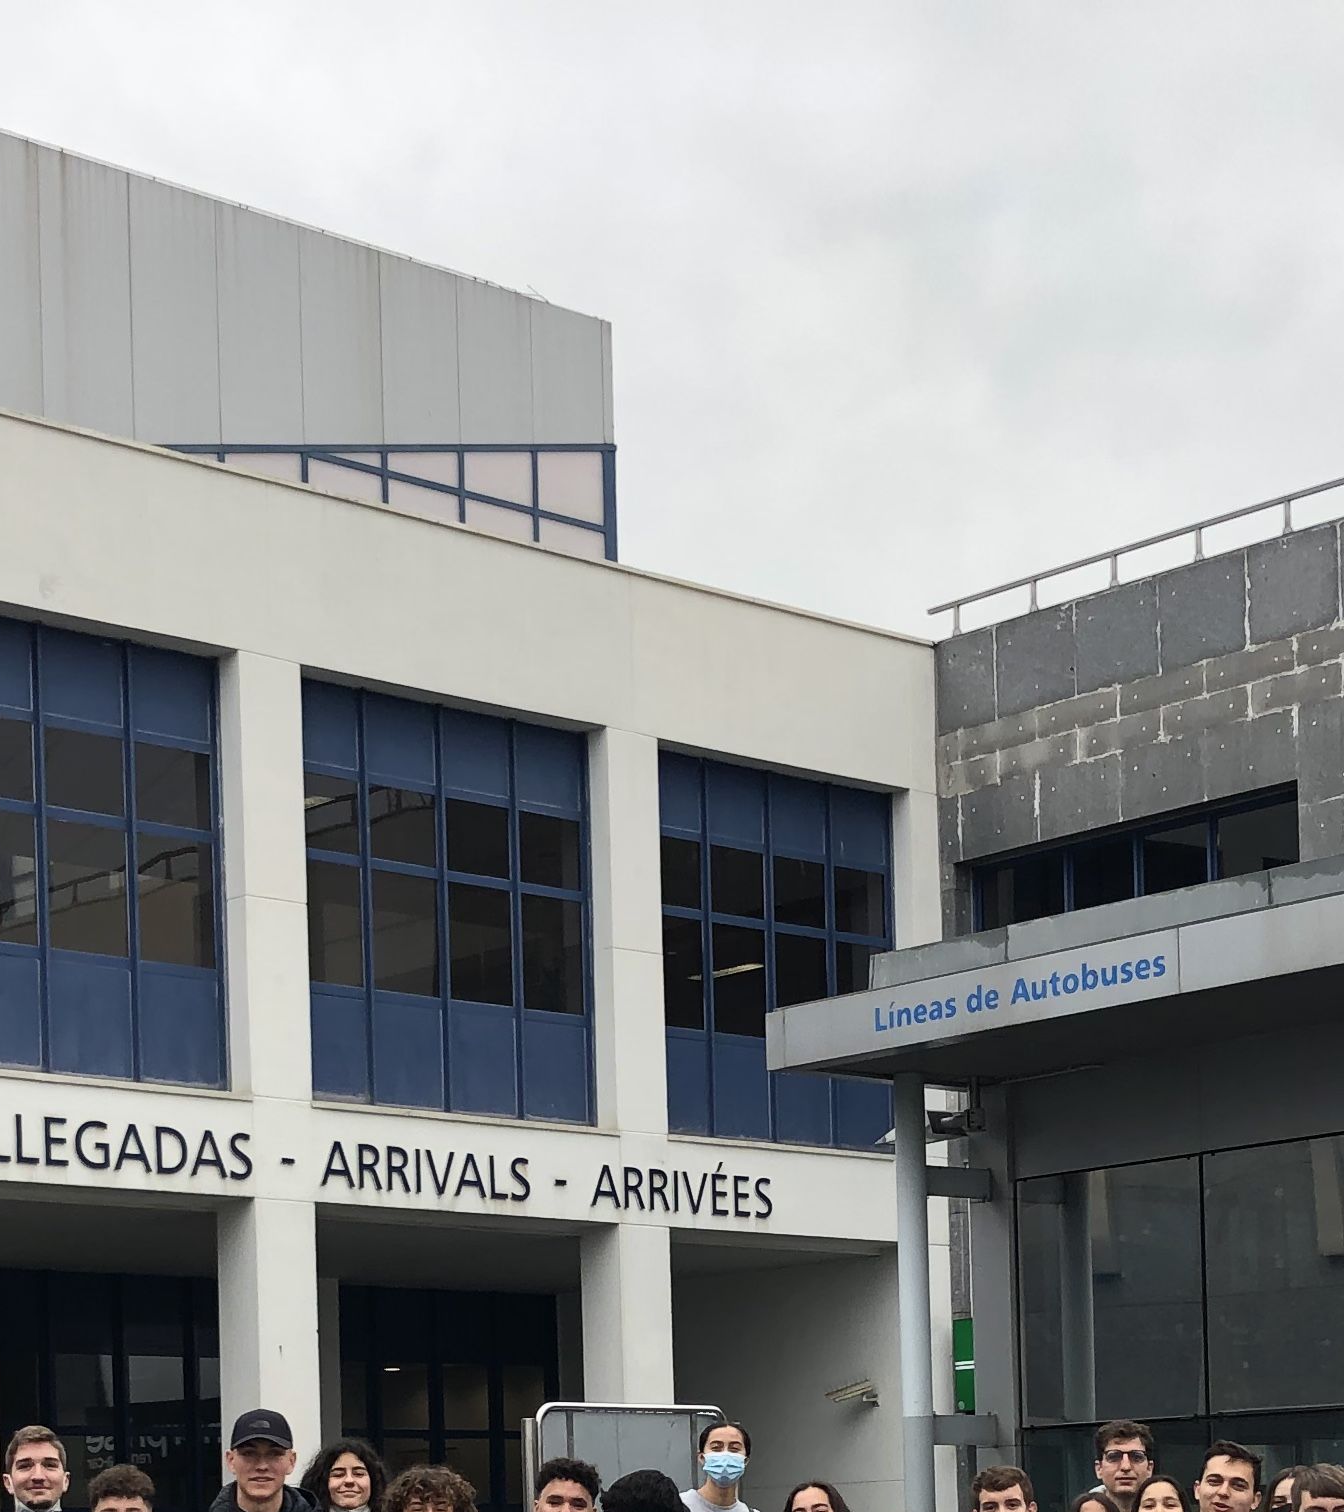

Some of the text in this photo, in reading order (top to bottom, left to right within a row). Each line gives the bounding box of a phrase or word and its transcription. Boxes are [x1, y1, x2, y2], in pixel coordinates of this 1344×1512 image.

[874, 955, 1167, 1032] Líneas de Autobuses
[320, 1140, 531, 1202] ARRIVALS
[590, 1161, 773, 1218] ARRIVÉES
